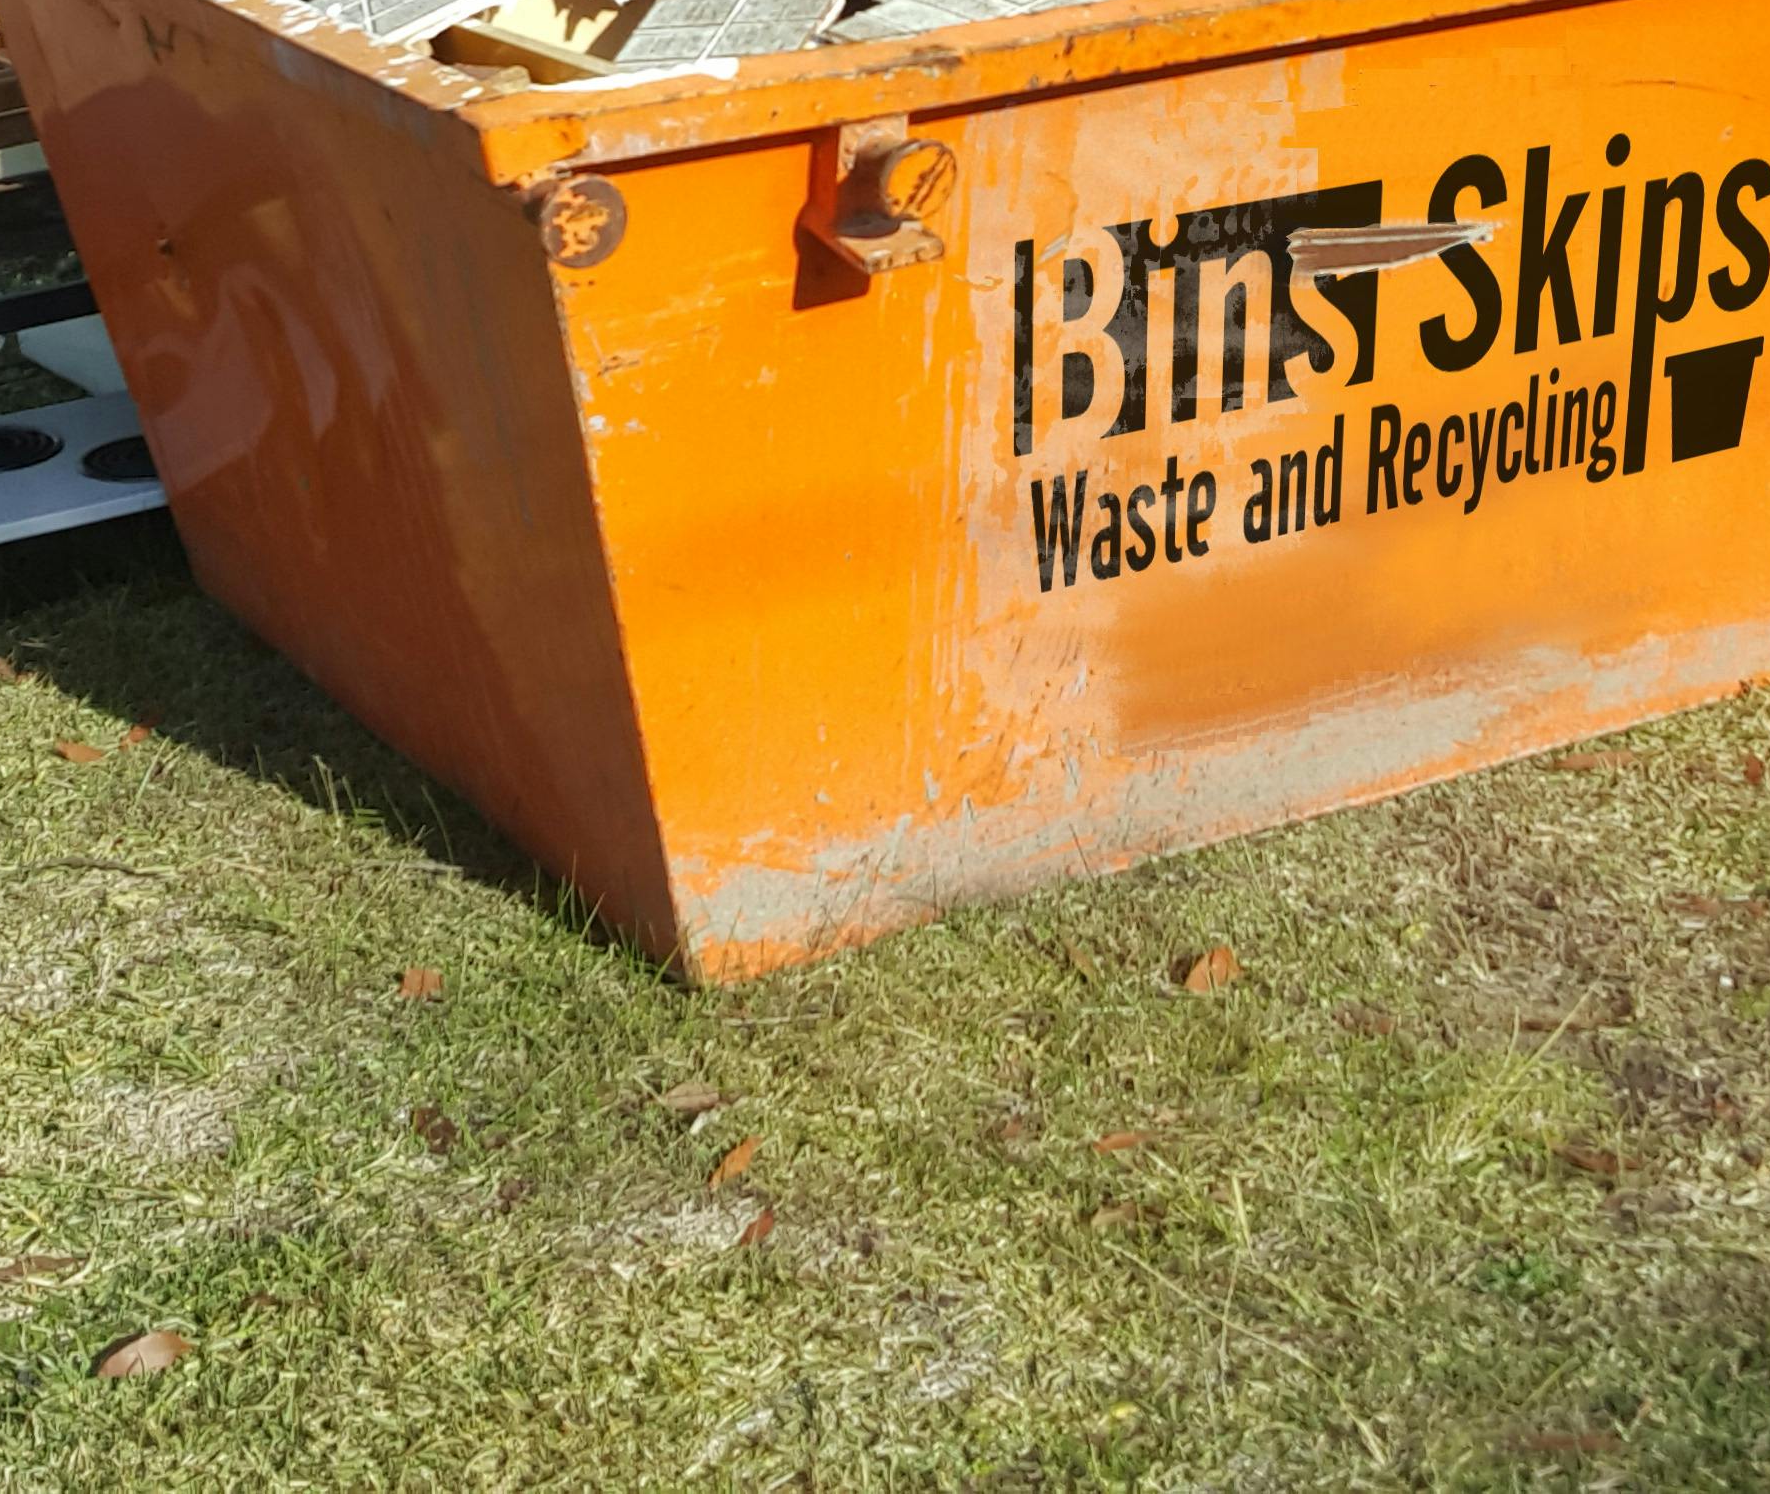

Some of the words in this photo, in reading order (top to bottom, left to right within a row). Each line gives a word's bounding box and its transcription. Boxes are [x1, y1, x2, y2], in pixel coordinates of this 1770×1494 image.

[1014, 184, 1381, 454] Bins
[1030, 470, 1216, 593] Waste
[1242, 414, 1344, 544] and
[1367, 368, 1617, 514] Recycling
